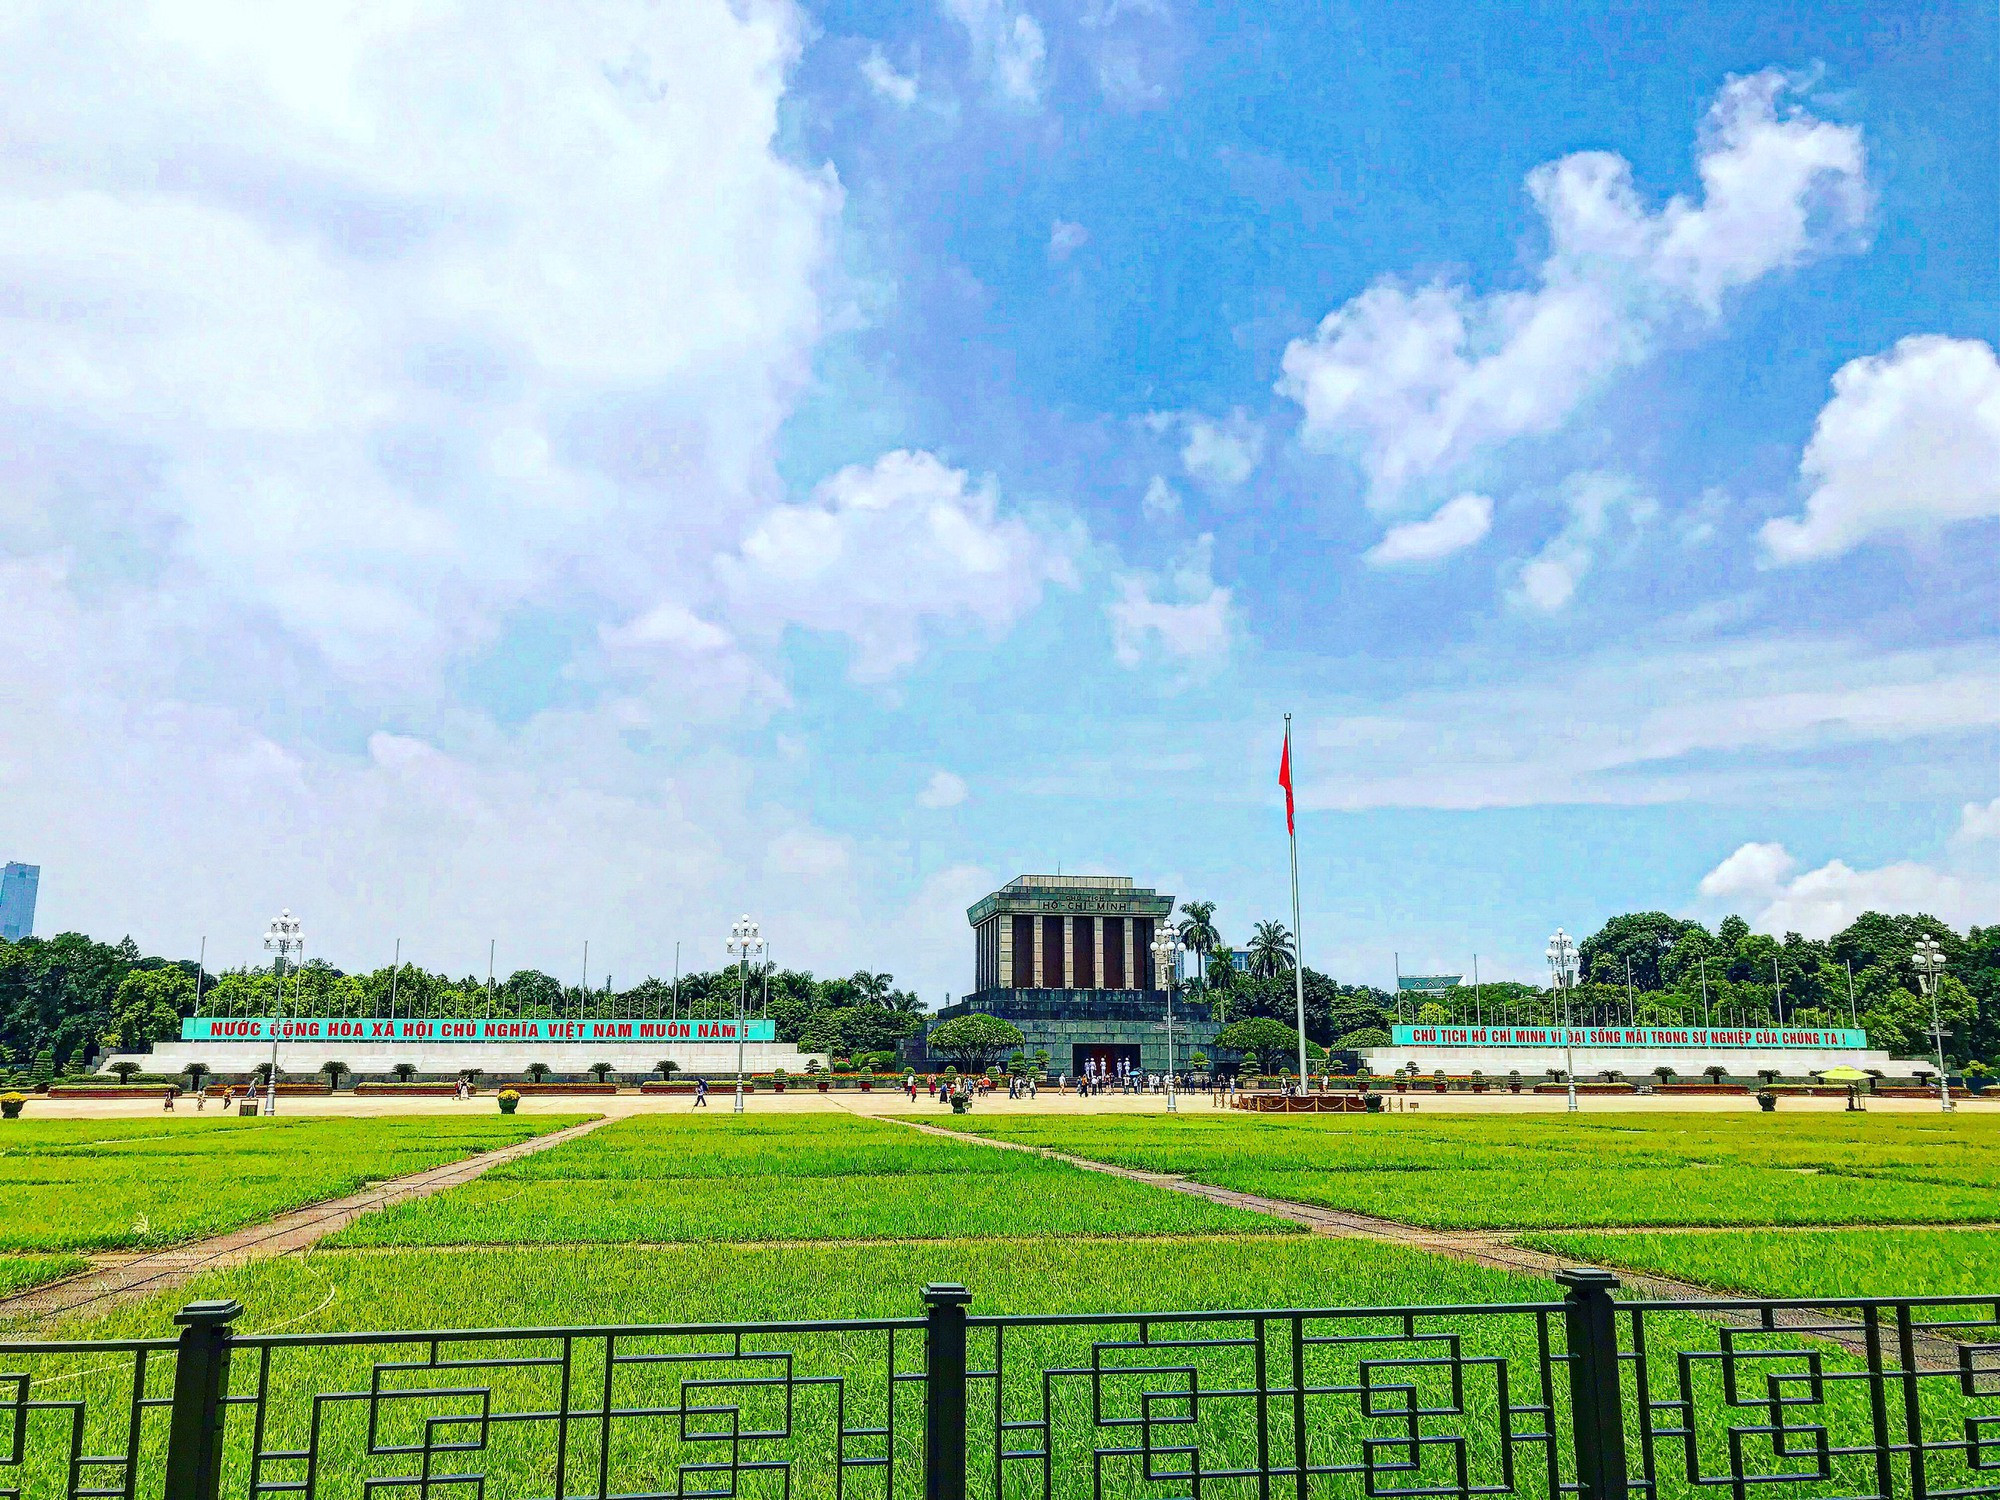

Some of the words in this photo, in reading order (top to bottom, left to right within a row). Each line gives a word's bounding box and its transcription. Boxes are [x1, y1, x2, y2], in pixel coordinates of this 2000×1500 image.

[210, 1020, 261, 1037] NƯỚC
[327, 1020, 364, 1037] HÒA
[371, 1020, 395, 1037] XÃ
[402, 1020, 434, 1039] HỘI
[441, 1019, 477, 1037] CHỦ
[484, 1021, 539, 1037] NGHĨA
[547, 1021, 586, 1039] VIỆT
[593, 1023, 633, 1037] NAM
[640, 1021, 691, 1037] MUÔN
[697, 1021, 736, 1037] NĂM
[1413, 1026, 1437, 1042] CHỦ
[1441, 1029, 1467, 1044] TỊCH
[1471, 1026, 1487, 1042] HỒ
[1491, 1028, 1511, 1042] CHÍ
[1515, 1030, 1546, 1043] MINH
[1590, 1028, 1621, 1043] SỐNG
[1625, 1028, 1647, 1043] MÃI
[1651, 1031, 1688, 1043] TRONG
[1692, 1029, 1707, 1045] SỰ
[1711, 1029, 1752, 1046] NGHIỆP
[1756, 1028, 1778, 1044] CỦA
[1782, 1030, 1820, 1045] CHÚNG
[1823, 1032, 1838, 1044] TA
